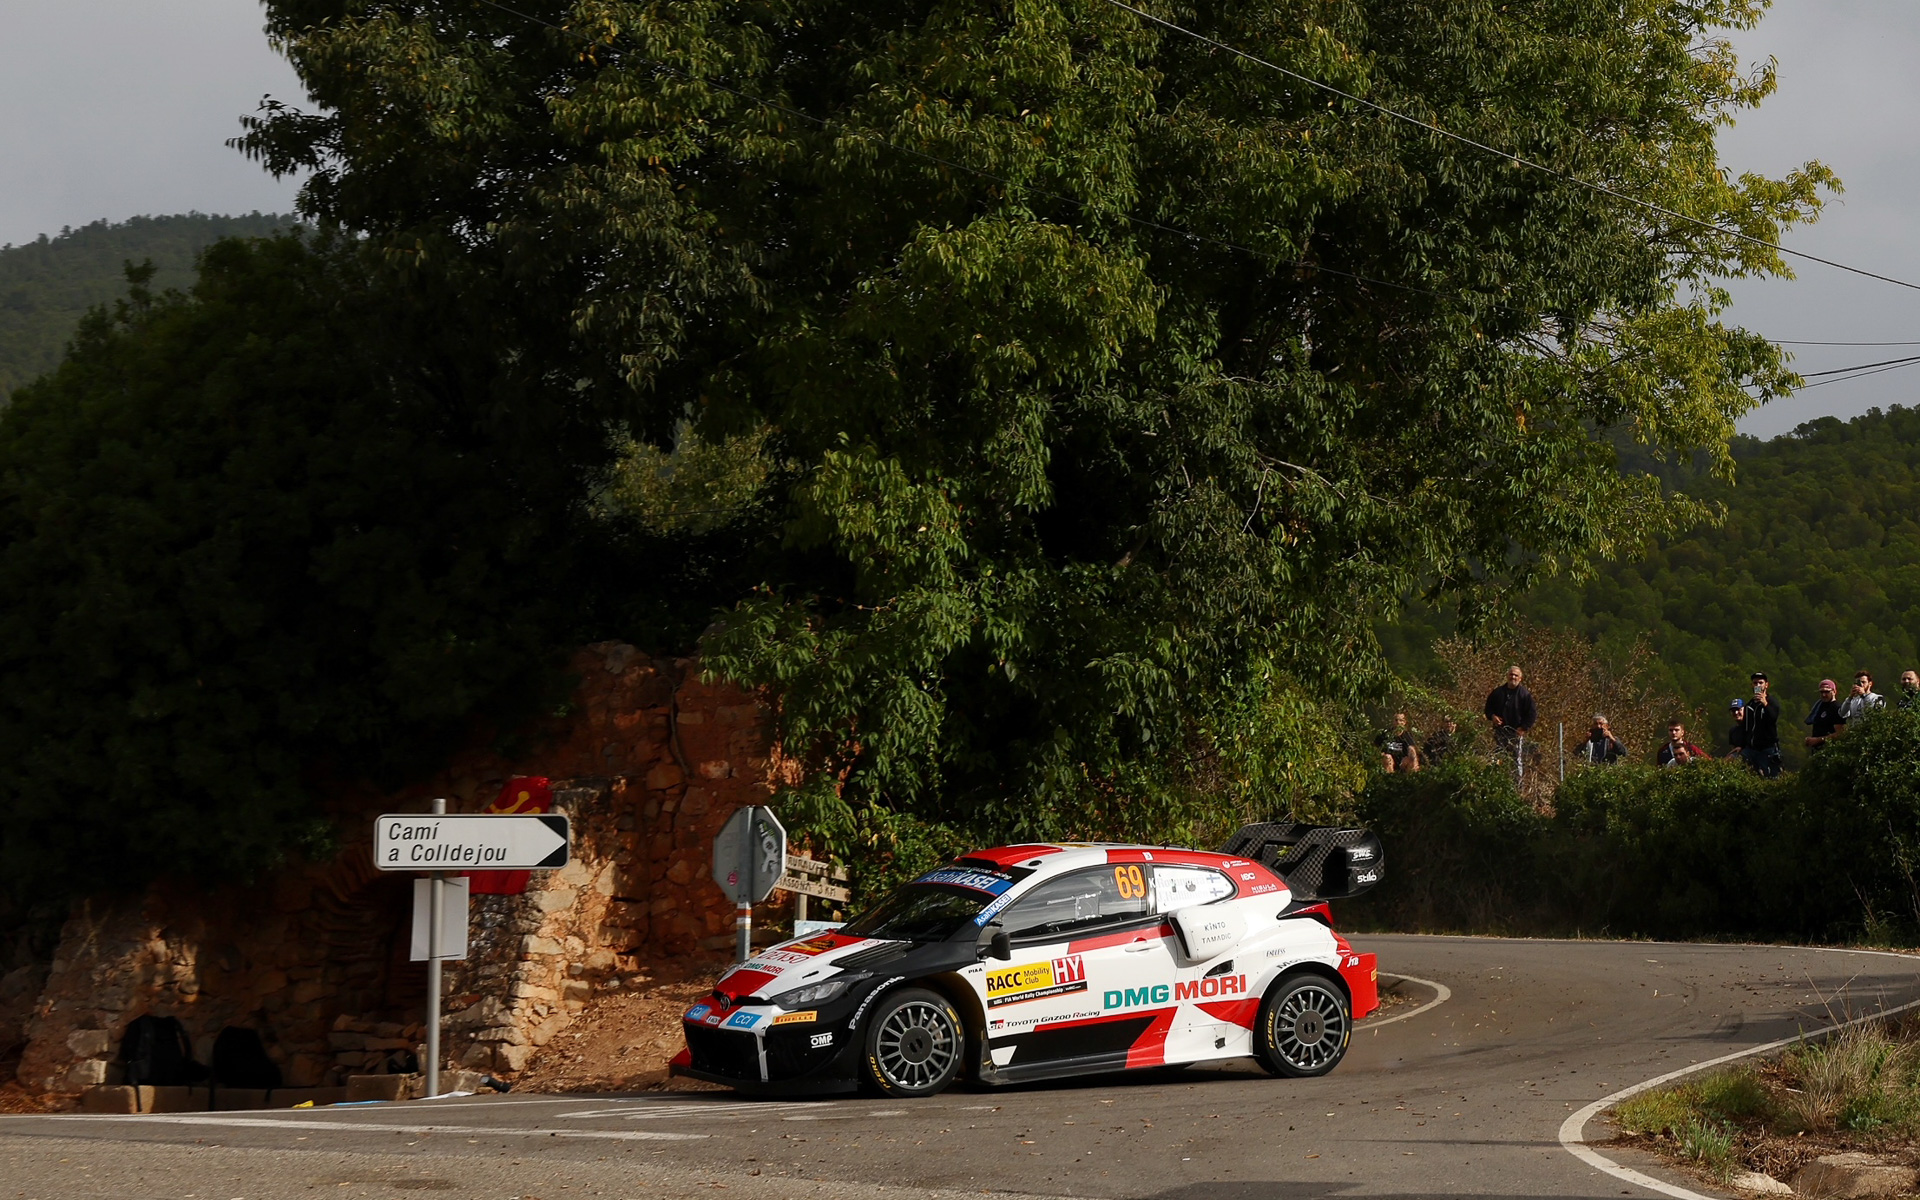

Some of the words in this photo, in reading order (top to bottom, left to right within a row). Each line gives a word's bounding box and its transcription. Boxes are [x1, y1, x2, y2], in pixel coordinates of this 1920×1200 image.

[389, 822, 440, 840] Camí
[388, 847, 400, 861] a
[411, 844, 507, 865] Colldejou
[1114, 865, 1146, 899] 69
[1357, 869, 1377, 883] Stilo
[1202, 933, 1232, 944] TAMADIC
[759, 951, 810, 964] DENSO
[761, 964, 785, 974] MORI
[1023, 967, 1050, 978] Mobility
[1053, 955, 1081, 984] HY
[986, 972, 1022, 992] RACC
[1024, 976, 1039, 985] Club
[1035, 988, 1064, 998] Championship
[1103, 984, 1170, 1010] DMG
[1175, 974, 1247, 1001] MORI
[848, 975, 905, 1030] Panasonic
[1006, 1019, 1039, 1028] TOYOTA
[1040, 1014, 1071, 1023] GAZOO
[1072, 1010, 1101, 1019] Racing
[810, 1034, 833, 1047] OMP
